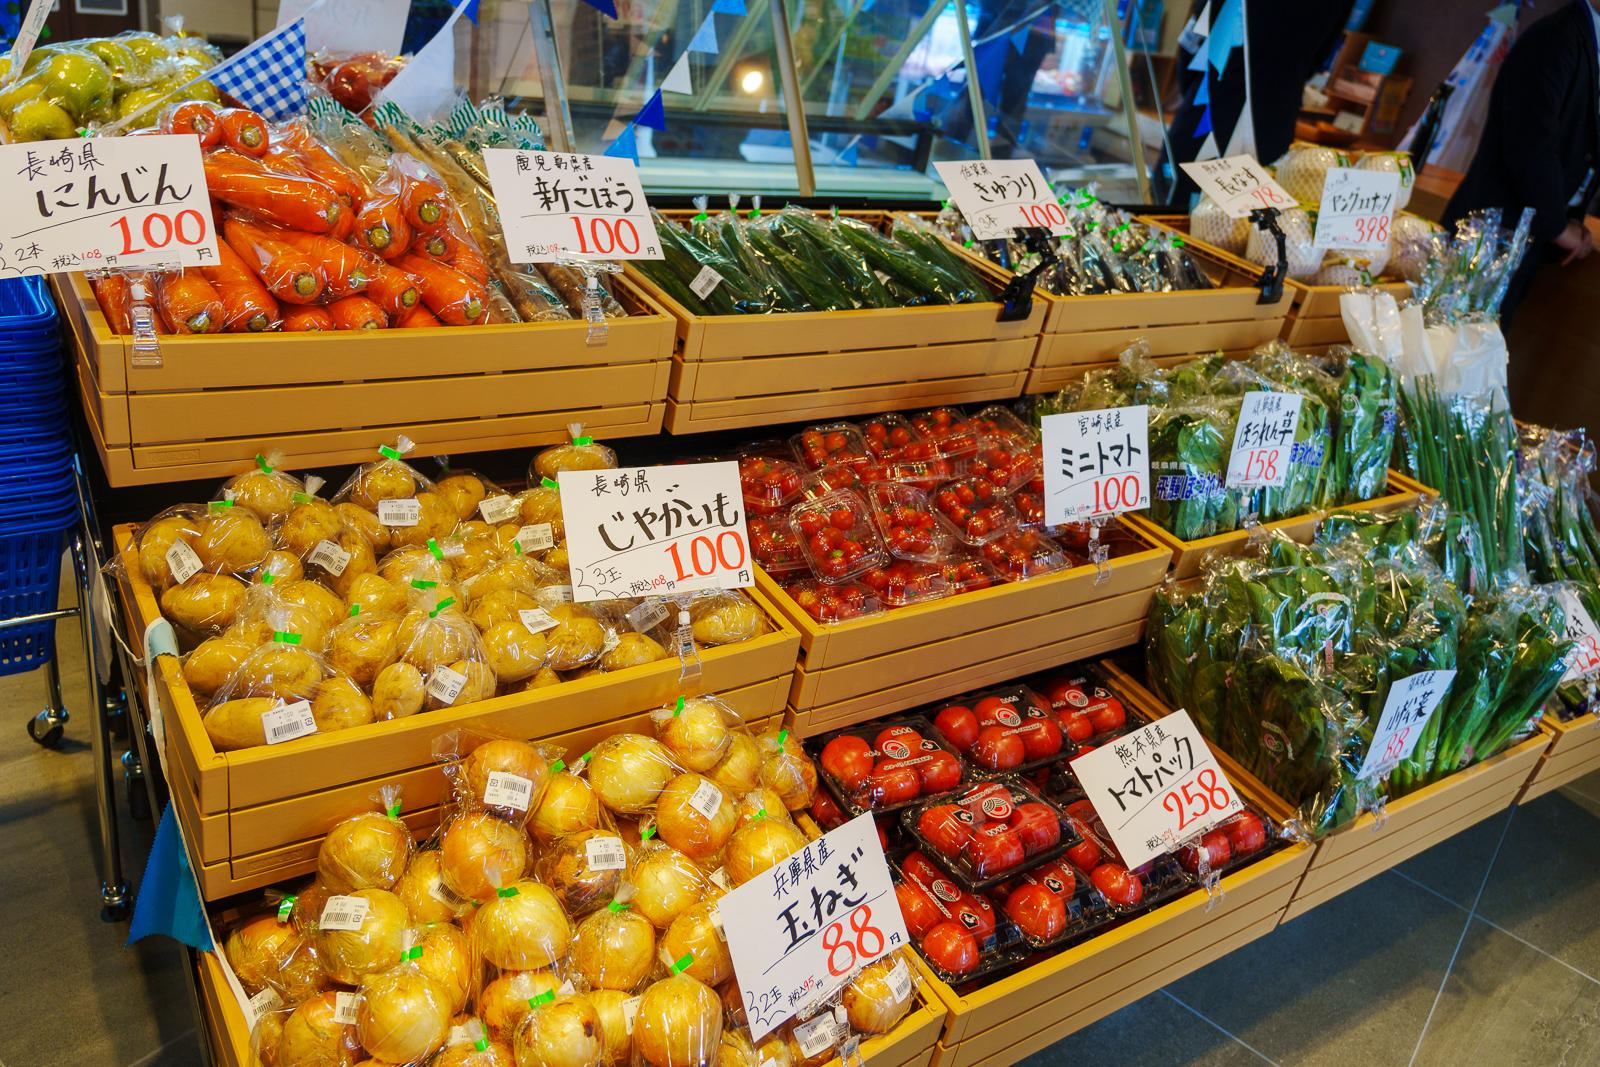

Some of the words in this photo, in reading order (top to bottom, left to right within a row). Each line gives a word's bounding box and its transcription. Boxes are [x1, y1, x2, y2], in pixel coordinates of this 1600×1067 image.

[17, 142, 104, 181] 長崎県
[515, 154, 594, 175] 鹿児島県産
[1214, 166, 1260, 195] 長なす
[36, 163, 192, 217] にんじん
[533, 175, 635, 213] 新ごぼう
[973, 173, 1037, 202] きゅうり
[1251, 185, 1284, 209] 78
[110, 209, 206, 256] 100
[570, 216, 640, 254] 100
[1019, 203, 1066, 229] 100
[1353, 215, 1389, 244] 398
[15, 242, 44, 261] 2本
[1077, 410, 1124, 437] 宮崎県産
[1237, 411, 1294, 449] ほうれん草
[1061, 433, 1141, 479] ミニトマト
[1244, 449, 1279, 481] 158
[591, 469, 651, 496] 長崎県
[1091, 475, 1140, 515] 100
[598, 484, 738, 552] じゃがいも
[664, 530, 745, 582] 100
[593, 566, 622, 585] 3玉
[1385, 689, 1435, 732] 小松菜
[1113, 724, 1171, 768] 熊本県産
[1382, 726, 1410, 763] 88
[1107, 736, 1194, 812] トマトパック
[1162, 768, 1230, 831] 258
[773, 837, 835, 900] 兵庫県産
[776, 846, 868, 955] 玉ねぎ
[822, 904, 885, 977] 88
[759, 985, 783, 1013] 2玉
